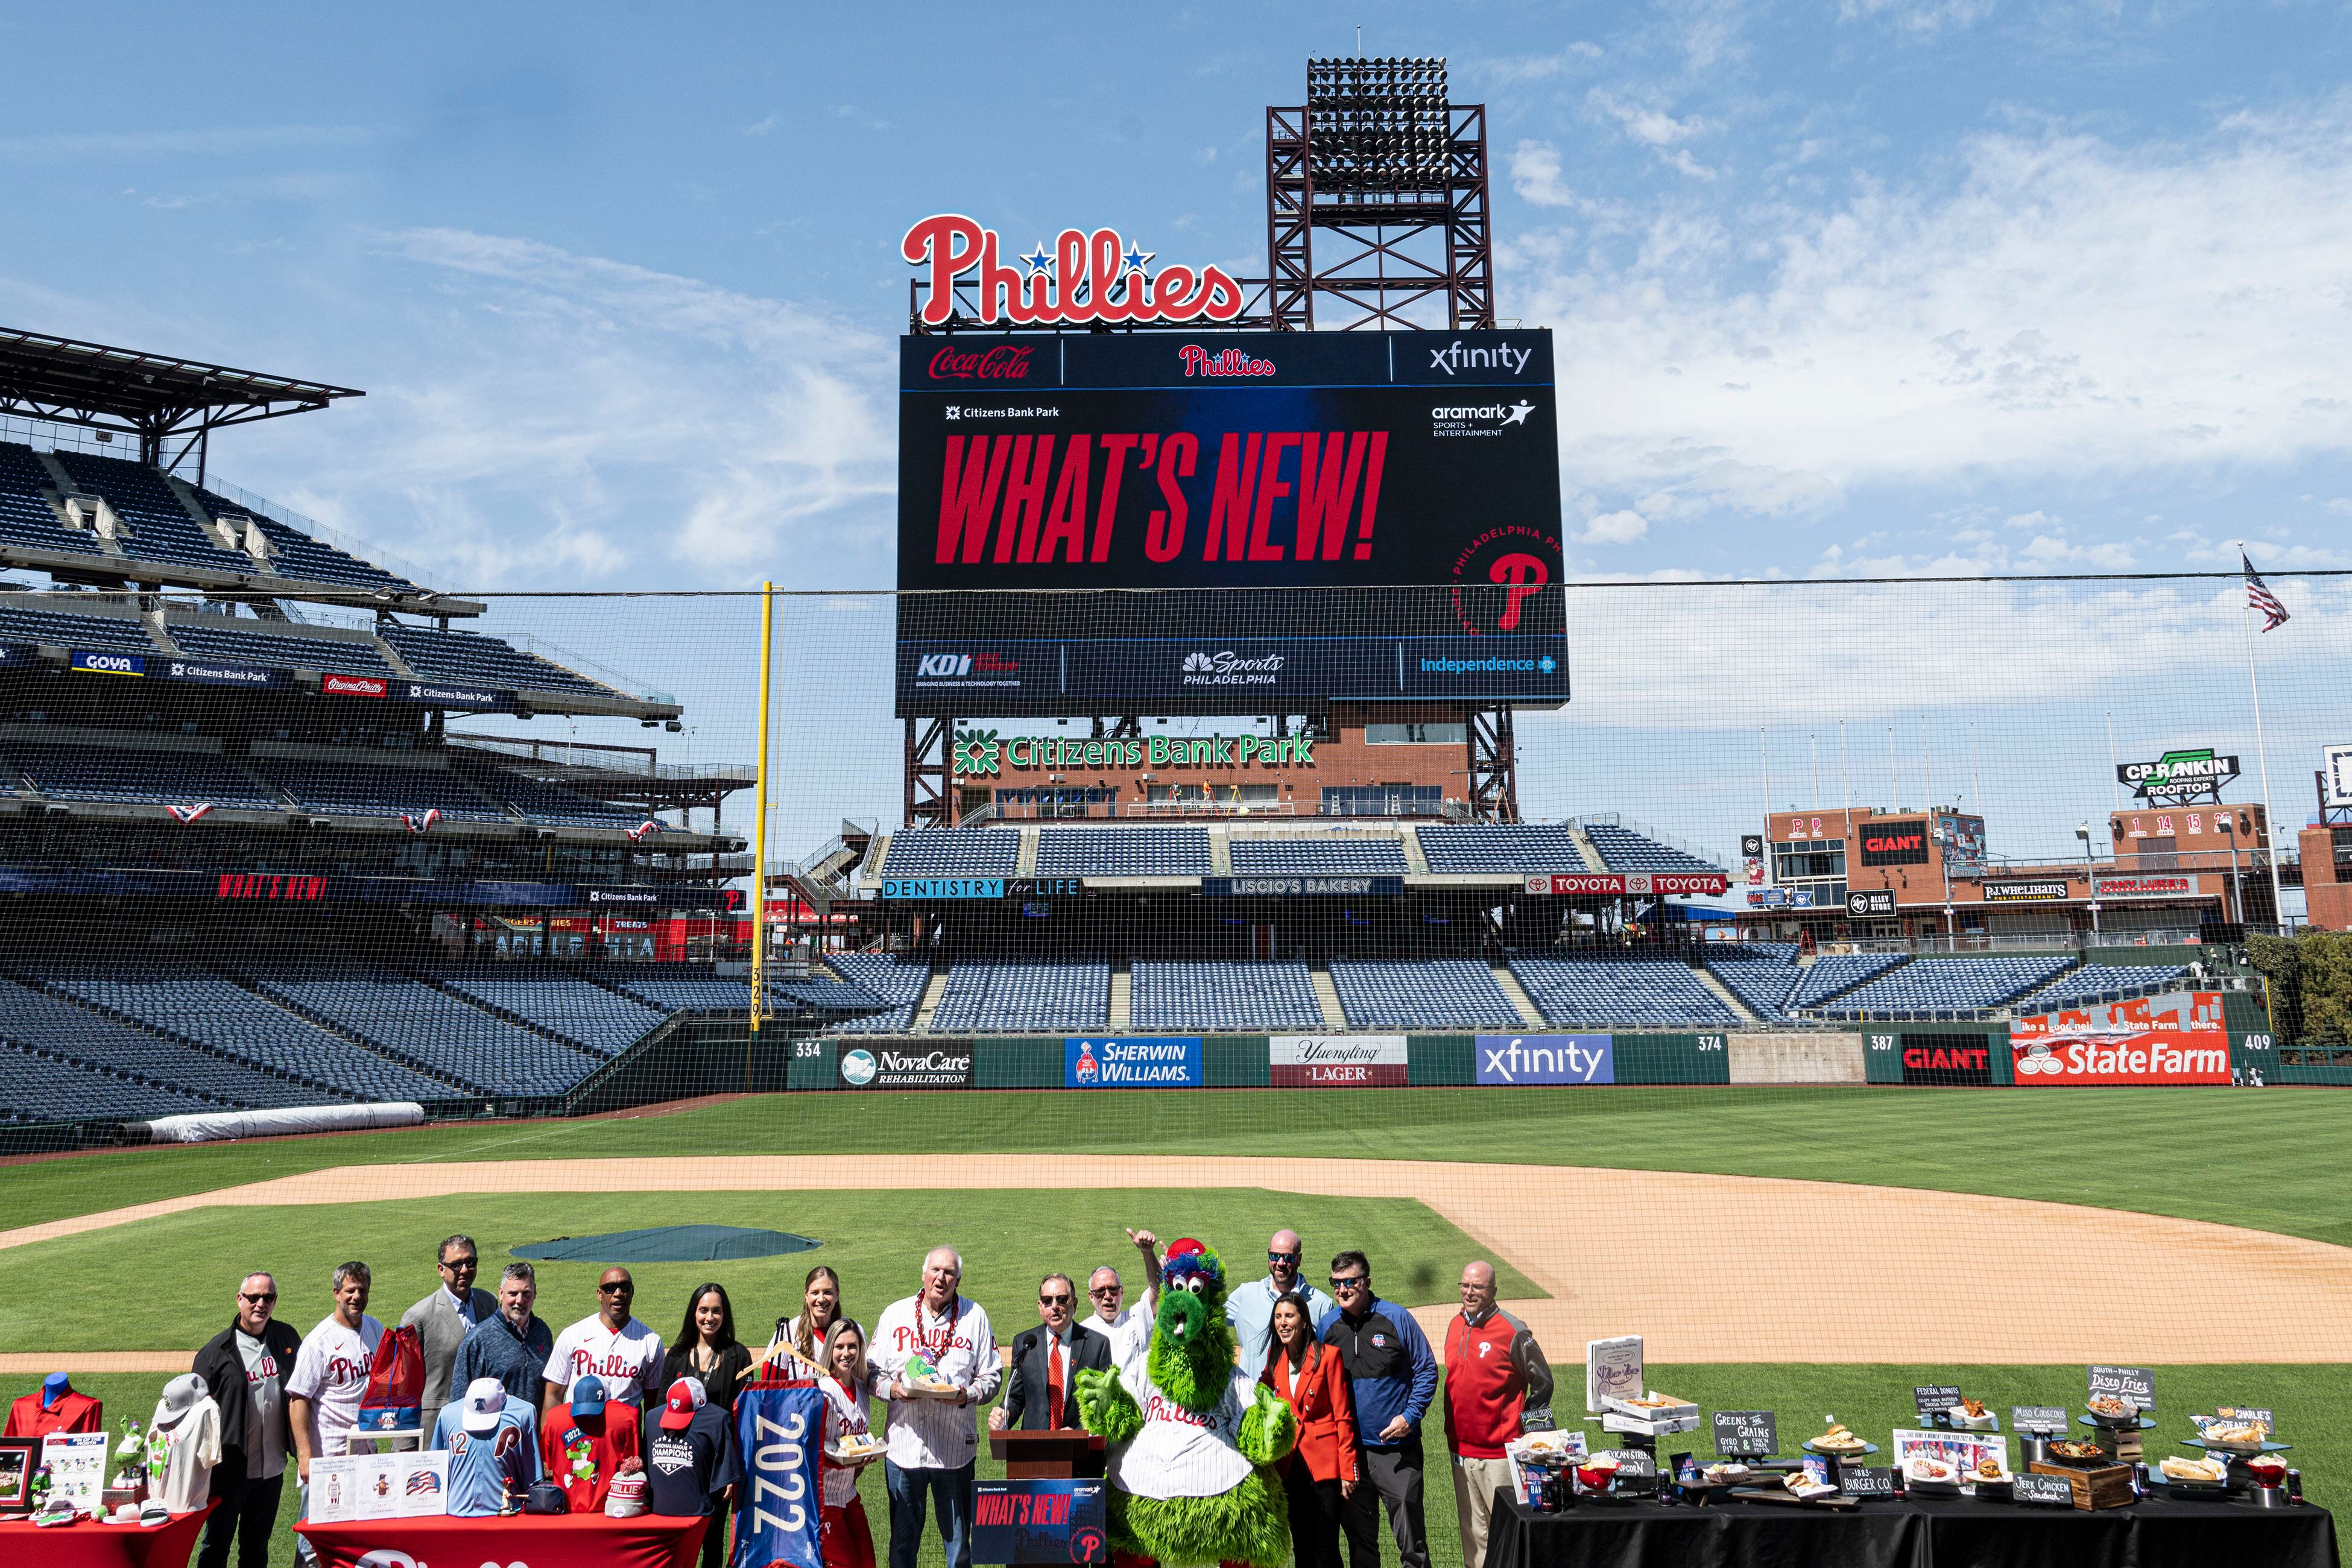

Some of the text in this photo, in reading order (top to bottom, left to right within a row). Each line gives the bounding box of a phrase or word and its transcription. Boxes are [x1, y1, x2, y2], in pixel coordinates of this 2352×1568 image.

[901, 213, 1244, 326] Phillies
[929, 345, 1035, 381] Coca-Cola
[1179, 344, 1276, 377] Phillies
[1430, 340, 1532, 375] xfinity
[964, 406, 1060, 418] Citizens Bank Park
[1432, 403, 1506, 419] aramark
[936, 431, 1389, 564] WHAT'S NEW!
[1453, 525, 1540, 575] PHILADELPHIA
[1489, 553, 1548, 630] P
[87, 656, 131, 671] GOYA
[917, 654, 972, 676] KDI
[975, 662, 1019, 671] TECHNOLOGY
[1213, 651, 1283, 672] Sports
[1421, 657, 1534, 674] Independence
[187, 667, 267, 681] Citizens Bank Park
[1184, 674, 1276, 685] PHILADELPHIA
[328, 678, 383, 692] Original Philly
[424, 689, 493, 702] Citizens Bank Park
[1007, 730, 1314, 765] Citizens Bank Park
[2126, 759, 2230, 779] CP RANKIN
[2147, 783, 2211, 795] ROOFTOP
[1792, 819, 1803, 832] P
[2132, 817, 2140, 832] 1
[2157, 815, 2172, 830] 14
[2187, 814, 2201, 829] 15
[1865, 836, 1921, 852] GIANT
[218, 874, 328, 901] WHAT'S NEW!
[885, 880, 1077, 896] DENTISTRY for LIFE
[1231, 879, 1371, 894] LISCIO'S BAKERY
[1556, 878, 1621, 891] TOYOTA
[1657, 877, 1721, 890] TOYOTA
[2101, 878, 2189, 888] TONY LUKE'S
[726, 890, 739, 910] P
[1870, 895, 1889, 903] ALLEY
[1871, 902, 1891, 911] STORE
[2123, 1020, 2149, 1031] State
[2152, 1020, 2178, 1030] Farm
[2190, 1020, 2221, 1029] there.
[797, 1043, 821, 1057] 334
[1698, 1036, 1721, 1051] 374
[1871, 1035, 1892, 1050] 387
[2245, 1035, 2270, 1050] 409
[1102, 1042, 1186, 1061] SHERWIN
[1296, 1040, 1382, 1064] Yuengling
[1903, 1048, 1988, 1069] GIANT
[2067, 1043, 2225, 1074] State Farm
[878, 1051, 970, 1071] NovaCare
[1485, 1038, 1604, 1082] xfinity
[879, 1075, 966, 1084] REHABILITATION
[1312, 1067, 1367, 1081] LAGER
[893, 1326, 972, 1352] Phlles
[1479, 1341, 1491, 1358] P
[330, 1351, 375, 1384] Phill
[573, 1349, 644, 1380] Phillies
[2092, 1374, 2148, 1391] Disco Fries
[596, 1389, 603, 1400] P
[1715, 1413, 1747, 1426] GREENS
[2015, 1406, 2065, 1418] MISO COUSCOUS
[2218, 1408, 2271, 1420] Uncle CHARLIE'S
[839, 1418, 868, 1436] Philli
[1737, 1426, 1769, 1438] GRAINS
[2221, 1420, 2249, 1429] STEAKS
[494, 1426, 522, 1458] P
[564, 1427, 581, 1443] 2022
[449, 1431, 468, 1456] 12
[1743, 1440, 1750, 1450] &
[653, 1447, 693, 1460] CHAMPIONS
[753, 1413, 806, 1534] 2022
[1619, 1461, 1644, 1475] OPCORN
[1844, 1478, 1891, 1490] BURGER CO.
[2015, 1476, 2069, 1493] JERK CHICKEN
[975, 1494, 1071, 1525] WHAT'S NEW!
[824, 1521, 831, 1534] P
[1081, 1535, 1100, 1561] P
